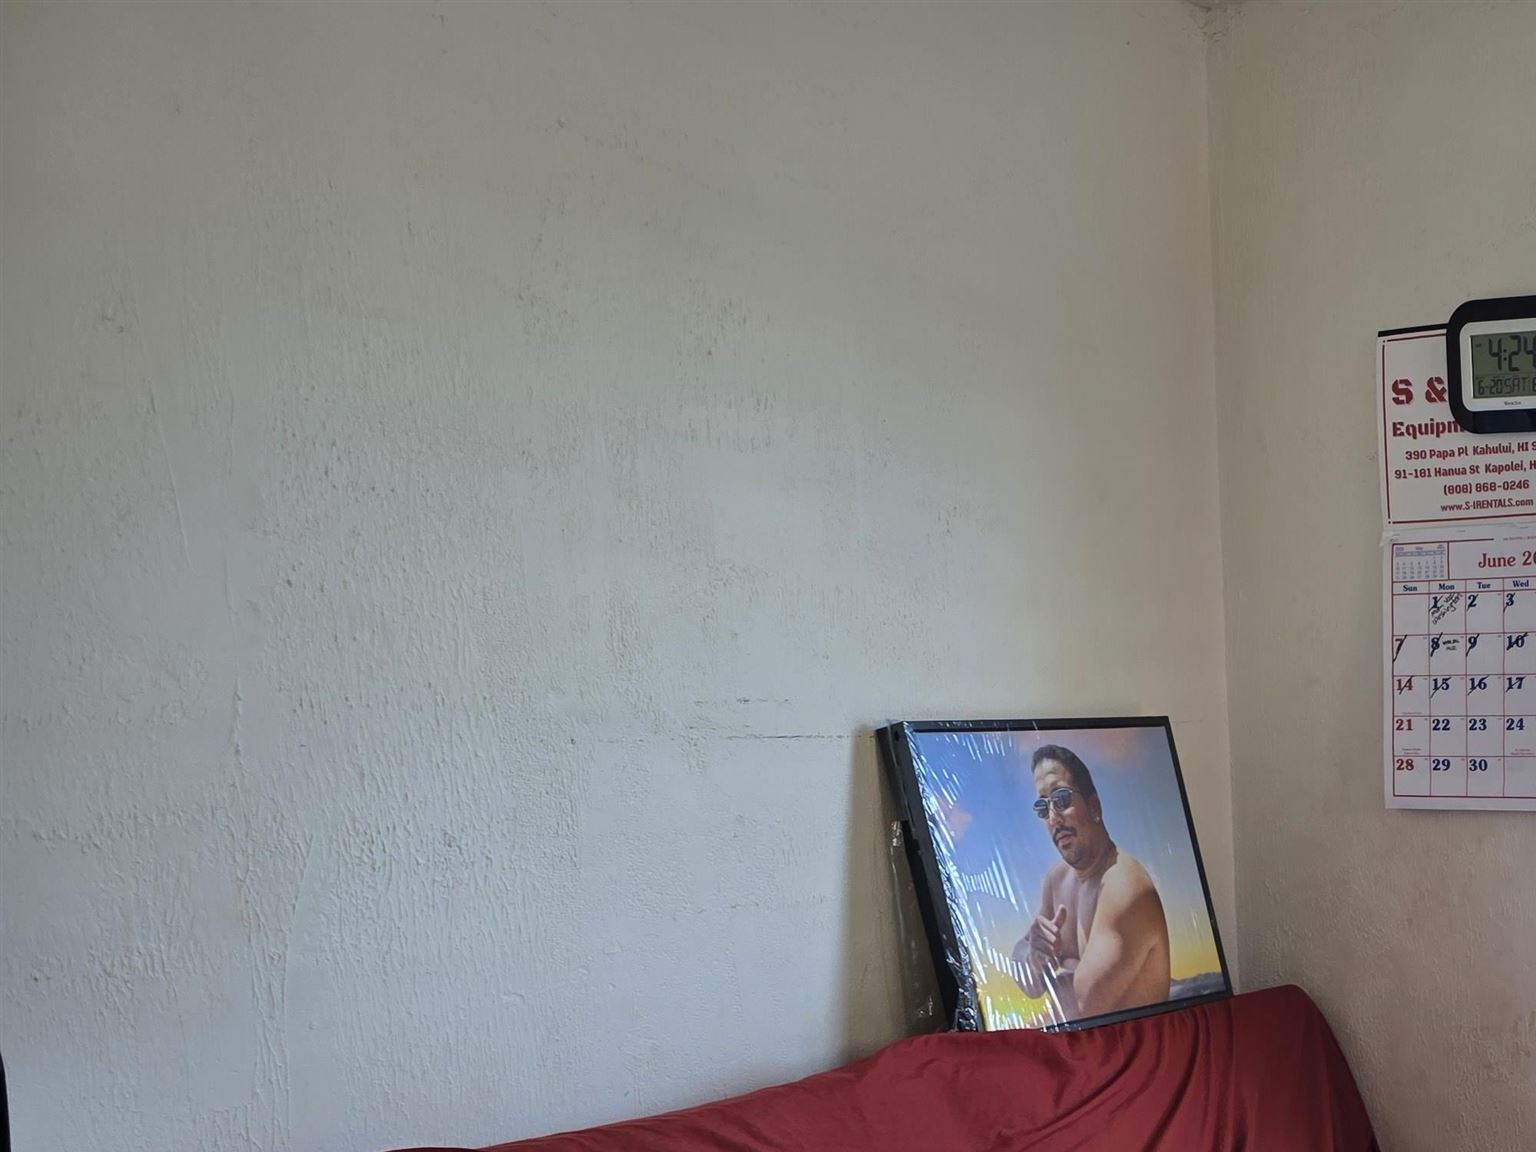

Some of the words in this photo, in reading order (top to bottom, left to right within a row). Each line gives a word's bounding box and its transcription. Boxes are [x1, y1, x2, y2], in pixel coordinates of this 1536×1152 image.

[1488, 335, 1536, 372] 4:24
[1391, 378, 1414, 405] S
[1425, 376, 1447, 404] &
[1392, 418, 1465, 440] Equipm
[1405, 449, 1427, 460] 390
[1429, 449, 1455, 460] Papa
[1457, 445, 1469, 456] Pl
[1472, 442, 1515, 456] Kahului,
[1517, 441, 1529, 452] HI
[1394, 467, 1432, 479] 91-181
[1434, 466, 1467, 477] Hanua
[1469, 464, 1480, 475] St
[1484, 460, 1527, 475] Kapolei,
[1443, 482, 1472, 496] (808)
[1475, 479, 1530, 493] 868-0246
[1477, 552, 1516, 568] June
[1402, 584, 1418, 592] Sun
[1438, 583, 1455, 591] Mon
[1477, 581, 1491, 589] Tue
[1512, 579, 1530, 588] Wed
[1432, 677, 1450, 691] 15
[1469, 677, 1488, 690] 16
[1506, 676, 1525, 690] 17
[1395, 718, 1413, 731] 21
[1432, 718, 1451, 731] 22
[1468, 718, 1488, 731] 23
[1506, 718, 1525, 731] 24
[1396, 758, 1414, 771] 28
[1432, 758, 1451, 771] 29
[1468, 758, 1488, 772] 30
